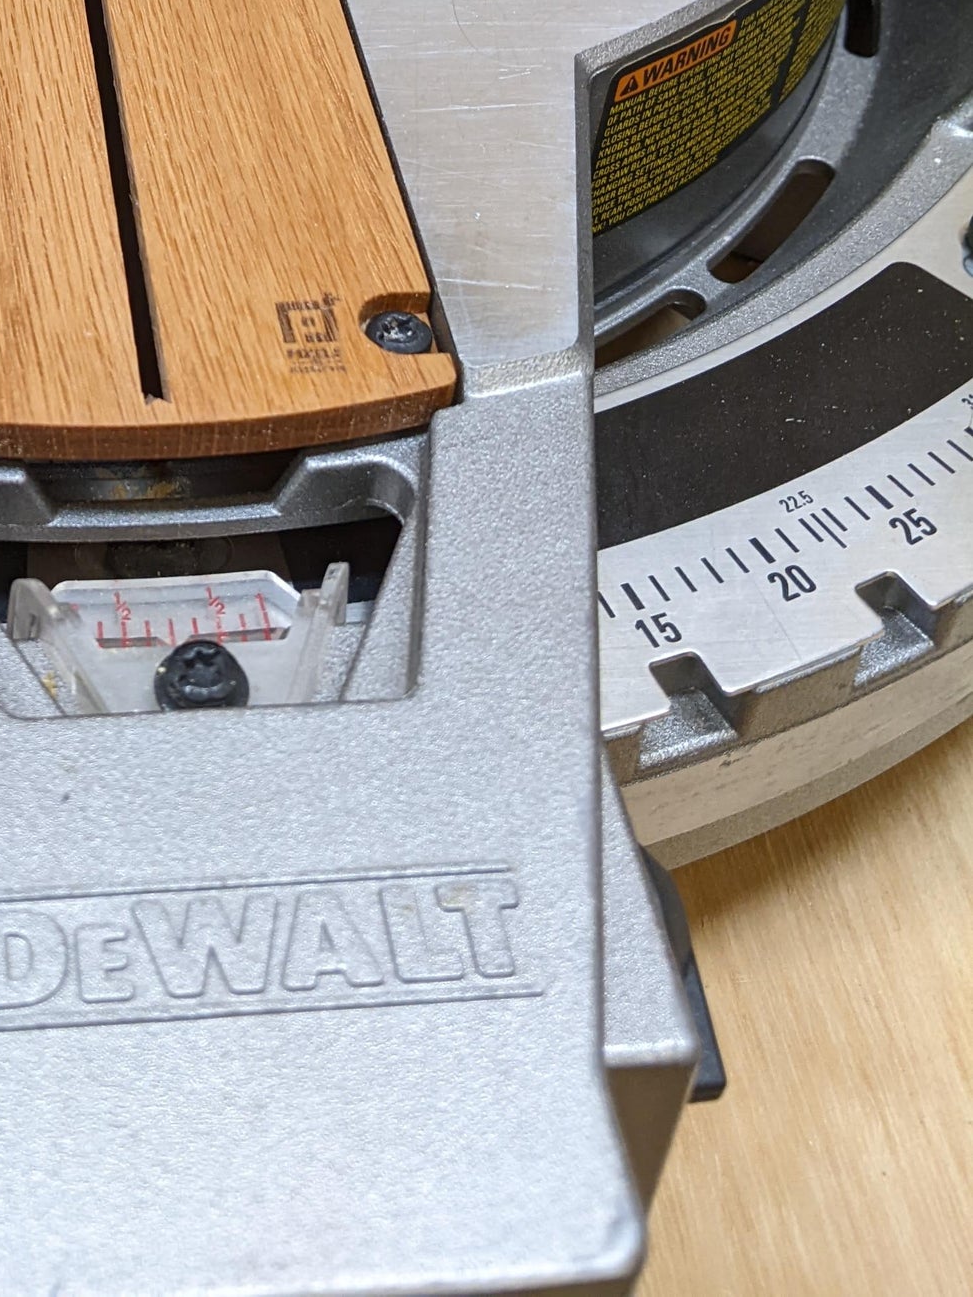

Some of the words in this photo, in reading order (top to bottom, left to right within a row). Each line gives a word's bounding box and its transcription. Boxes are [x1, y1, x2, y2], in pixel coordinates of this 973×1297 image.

[643, 26, 731, 82] WARNING
[607, 115, 619, 124] OF
[619, 104, 643, 119] PATH
[645, 97, 657, 108] OF
[657, 87, 677, 101] SAW
[609, 93, 646, 114] MANUAL
[601, 126, 638, 146] CLOSING
[603, 115, 640, 136] GUARDS
[641, 109, 653, 119] IN
[598, 139, 629, 157] KNOBS
[631, 122, 663, 142] BEFORE
[593, 162, 621, 178] CROSS
[609, 166, 629, 180] SAW
[591, 174, 633, 197] HANGING
[780, 490, 814, 513] 22.5
[889, 508, 938, 545] 25
[768, 565, 817, 602] 20
[635, 612, 682, 648] 15
